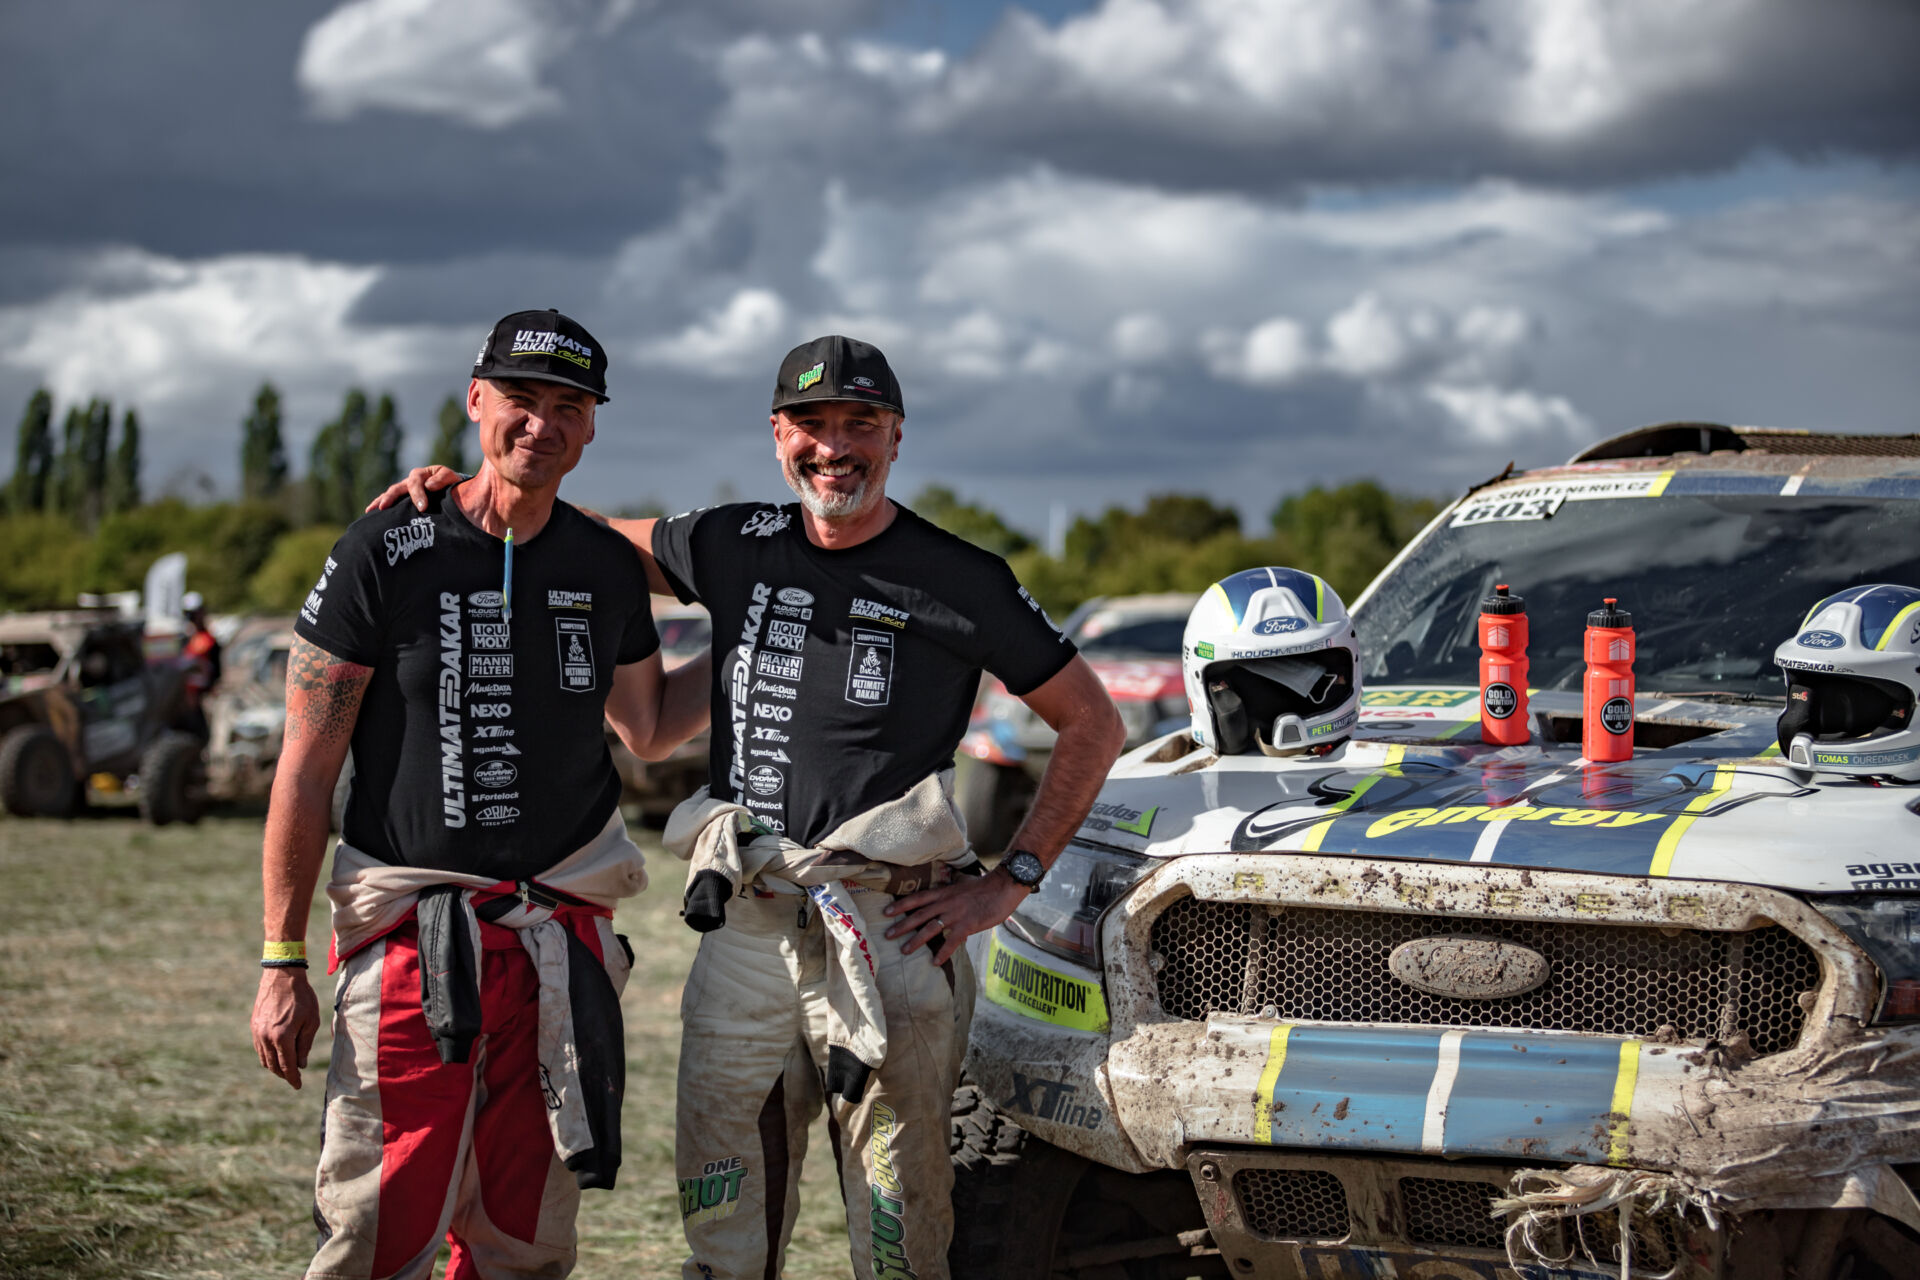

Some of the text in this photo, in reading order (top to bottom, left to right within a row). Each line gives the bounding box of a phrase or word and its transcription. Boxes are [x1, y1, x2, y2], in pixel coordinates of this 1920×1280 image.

[515, 330, 592, 357] ULTIMATE
[511, 342, 591, 369] DAKAR racing
[384, 522, 435, 566] SHOT
[401, 539, 434, 560] energy
[548, 590, 592, 602] ULTIMATE
[850, 607, 880, 619] DAKAR
[852, 598, 910, 620] ULTIMATE
[473, 624, 508, 635] LIQUI
[771, 621, 805, 636] LIQUI
[474, 637, 509, 648] MOLY
[767, 634, 803, 650] MOLY
[472, 656, 510, 665] MANN
[761, 653, 800, 668] MANN
[472, 665, 511, 675] FILTER
[565, 667, 591, 676] ULTIMATE
[760, 663, 799, 678] FILTER
[570, 677, 589, 685] DAKAR
[852, 679, 885, 691] ULTIMATE
[855, 689, 880, 700] DAKAR
[1488, 689, 1511, 699] GOLD
[470, 703, 512, 718] NEXO
[753, 702, 793, 722] NEXO
[1607, 705, 1630, 714] GOLD
[472, 725, 515, 738] XTline
[751, 726, 790, 743] XTline
[1312, 724, 1332, 735] PETR
[473, 745, 507, 754] agados
[750, 748, 779, 756] agados
[1817, 755, 1848, 763] TOMAS
[480, 792, 519, 801] Fortelock
[751, 801, 783, 810] Fortelock
[1366, 805, 1667, 839] energy
[1008, 986, 1058, 1017] BE EXCELLENT
[1003, 1072, 1101, 1130] XTline
[871, 1101, 902, 1193] energy
[704, 1157, 741, 1175] ONE
